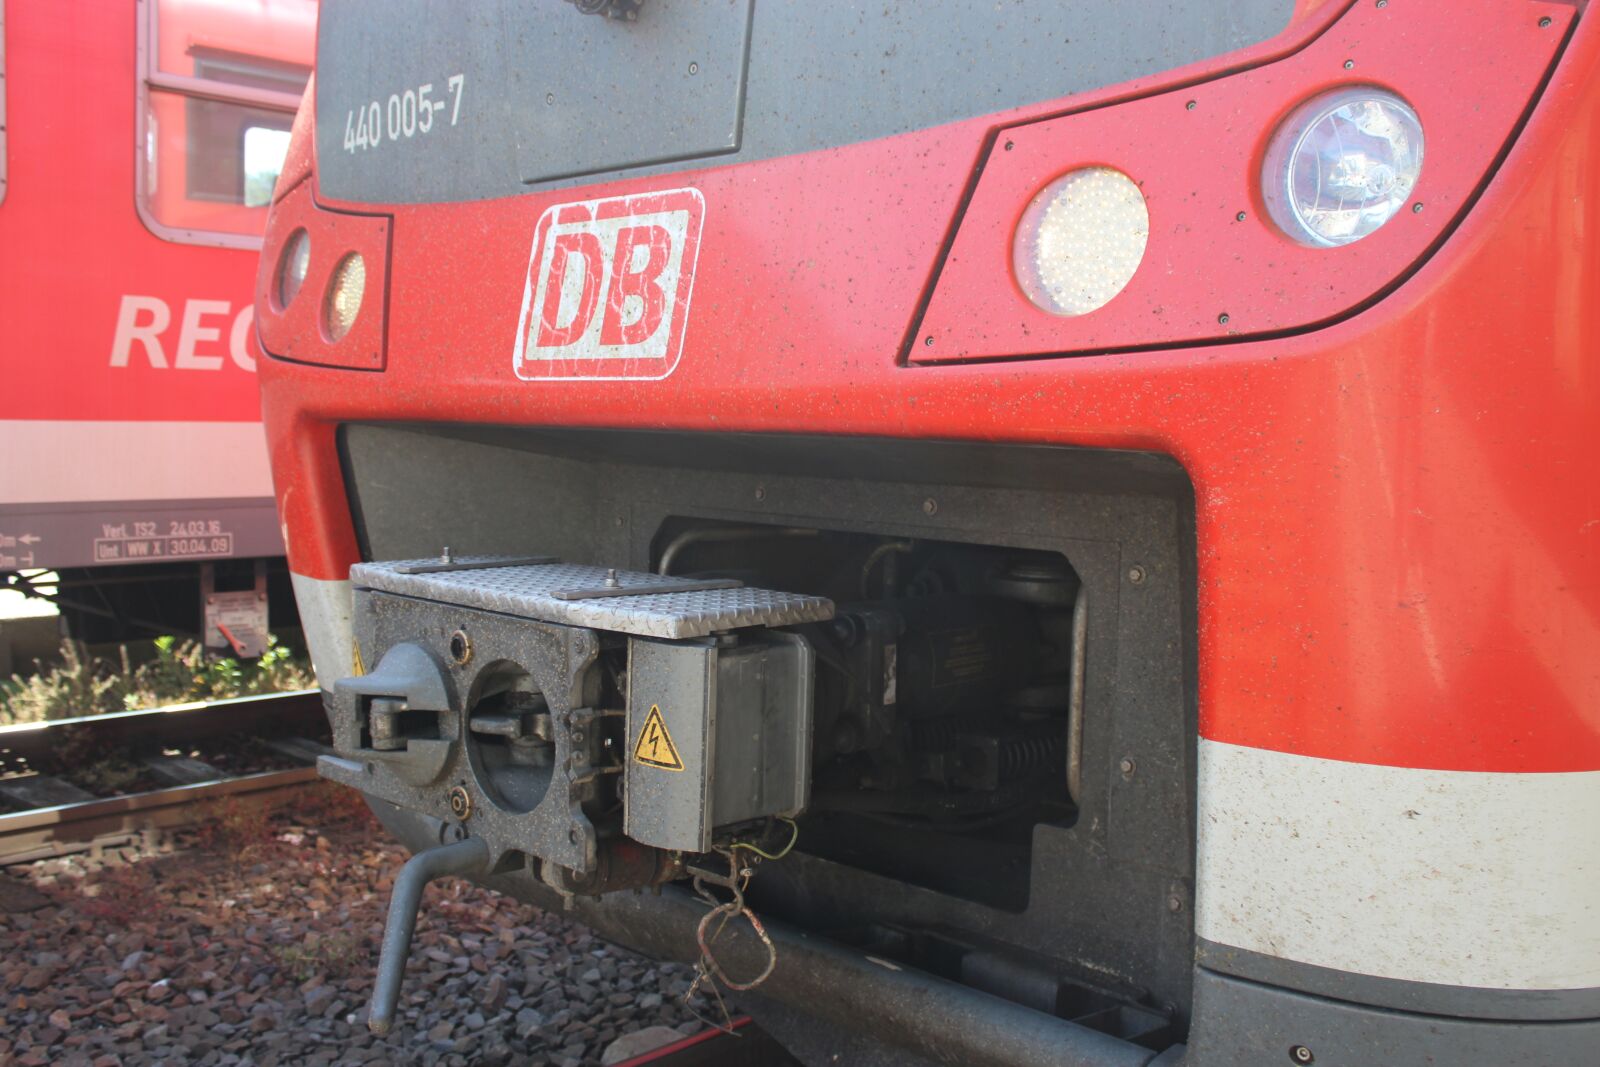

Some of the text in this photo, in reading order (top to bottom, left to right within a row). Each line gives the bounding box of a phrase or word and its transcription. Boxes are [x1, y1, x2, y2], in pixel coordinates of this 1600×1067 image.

[343, 74, 465, 154] 440 005-7
[533, 222, 675, 349] DB
